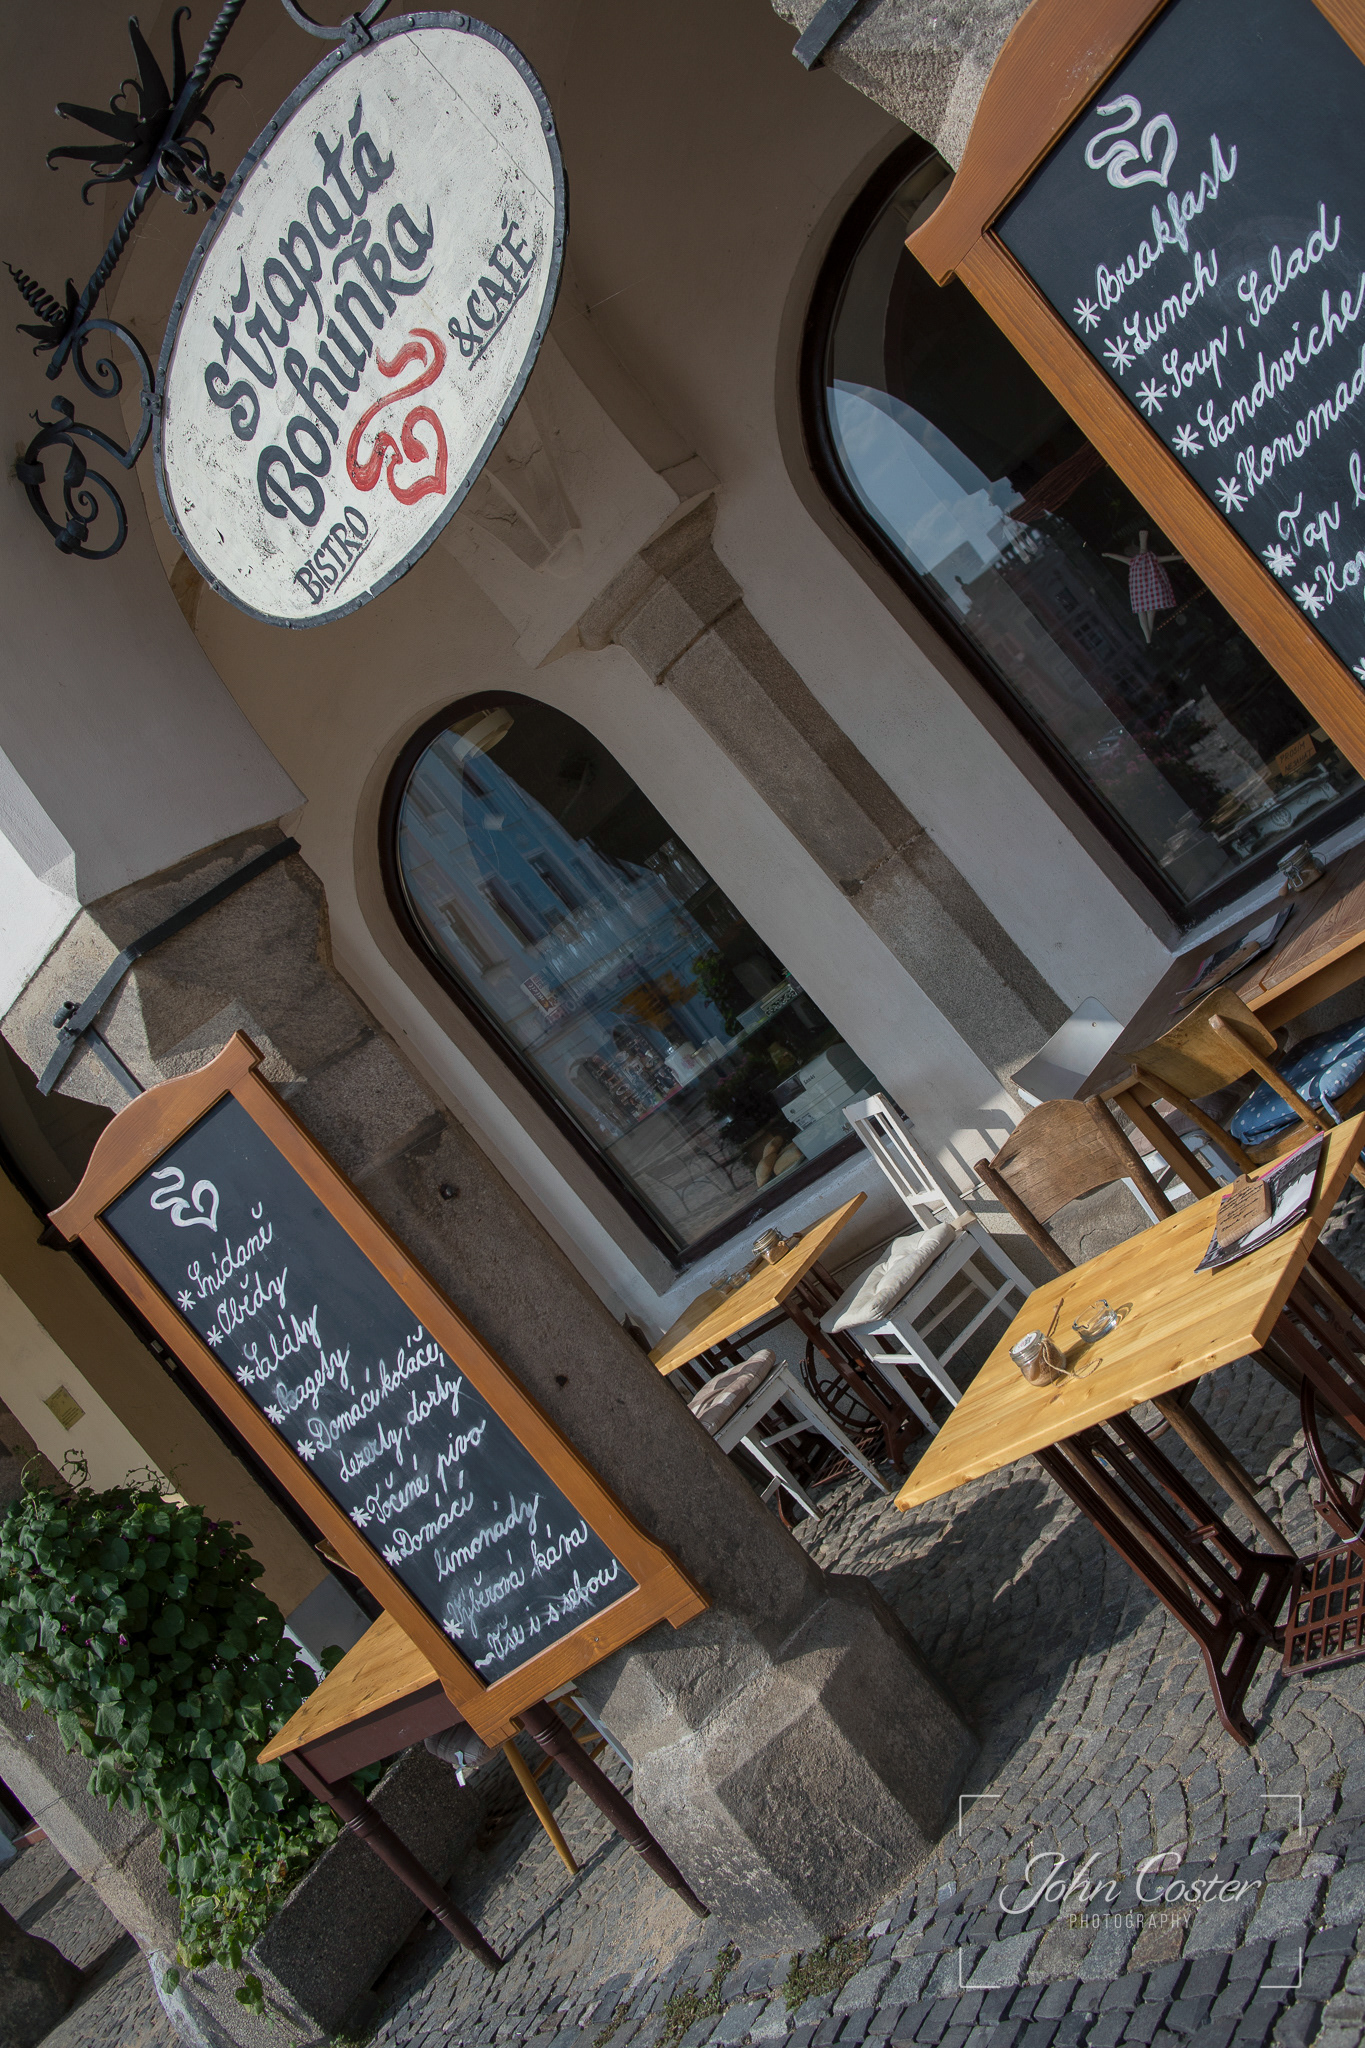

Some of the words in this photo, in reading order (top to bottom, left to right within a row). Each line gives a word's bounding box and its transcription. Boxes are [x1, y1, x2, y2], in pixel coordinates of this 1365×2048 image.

[1097, 133, 1237, 310] Breakfast
[1238, 201, 1341, 326] Salad
[1124, 249, 1217, 354] Lunch
[257, 203, 434, 527] Bohunka
[1197, 272, 1365, 448] Sandwiche
[1237, 343, 1365, 496] Homemad
[294, 505, 369, 604] BISTRO
[1278, 492, 1338, 556] Tap
[187, 1201, 273, 1298] Snídaně
[217, 1267, 287, 1335] Obědy
[244, 1304, 321, 1379] Saláty
[275, 1345, 350, 1414] Bagety
[307, 1366, 379, 1452] Domácí
[407, 1374, 463, 1425] dorty
[367, 1454, 429, 1523] Točené
[437, 1420, 486, 1493] pivo
[393, 1470, 474, 1557] Domácí
[434, 1491, 541, 1582] limonády
[531, 1520, 588, 1579] káva
[563, 1558, 618, 1615] sebou
